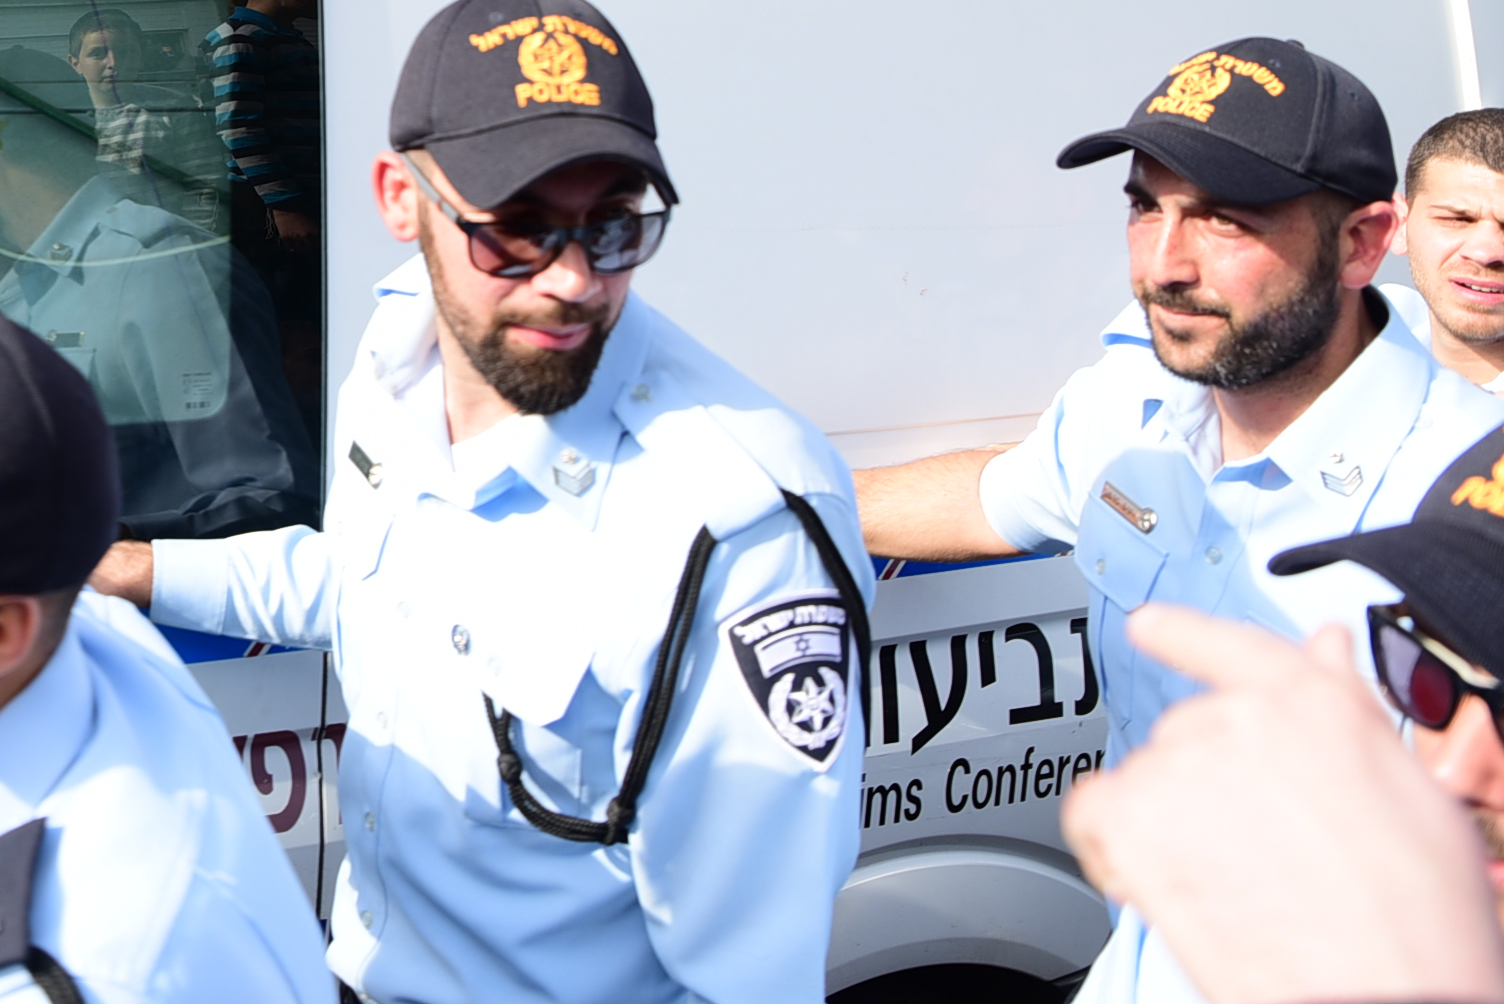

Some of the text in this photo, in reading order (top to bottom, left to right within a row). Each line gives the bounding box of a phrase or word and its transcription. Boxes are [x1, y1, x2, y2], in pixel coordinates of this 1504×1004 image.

[1213, 53, 1286, 97] משטרת
[515, 81, 602, 108] POLICE
[1146, 95, 1216, 123] POLICE
